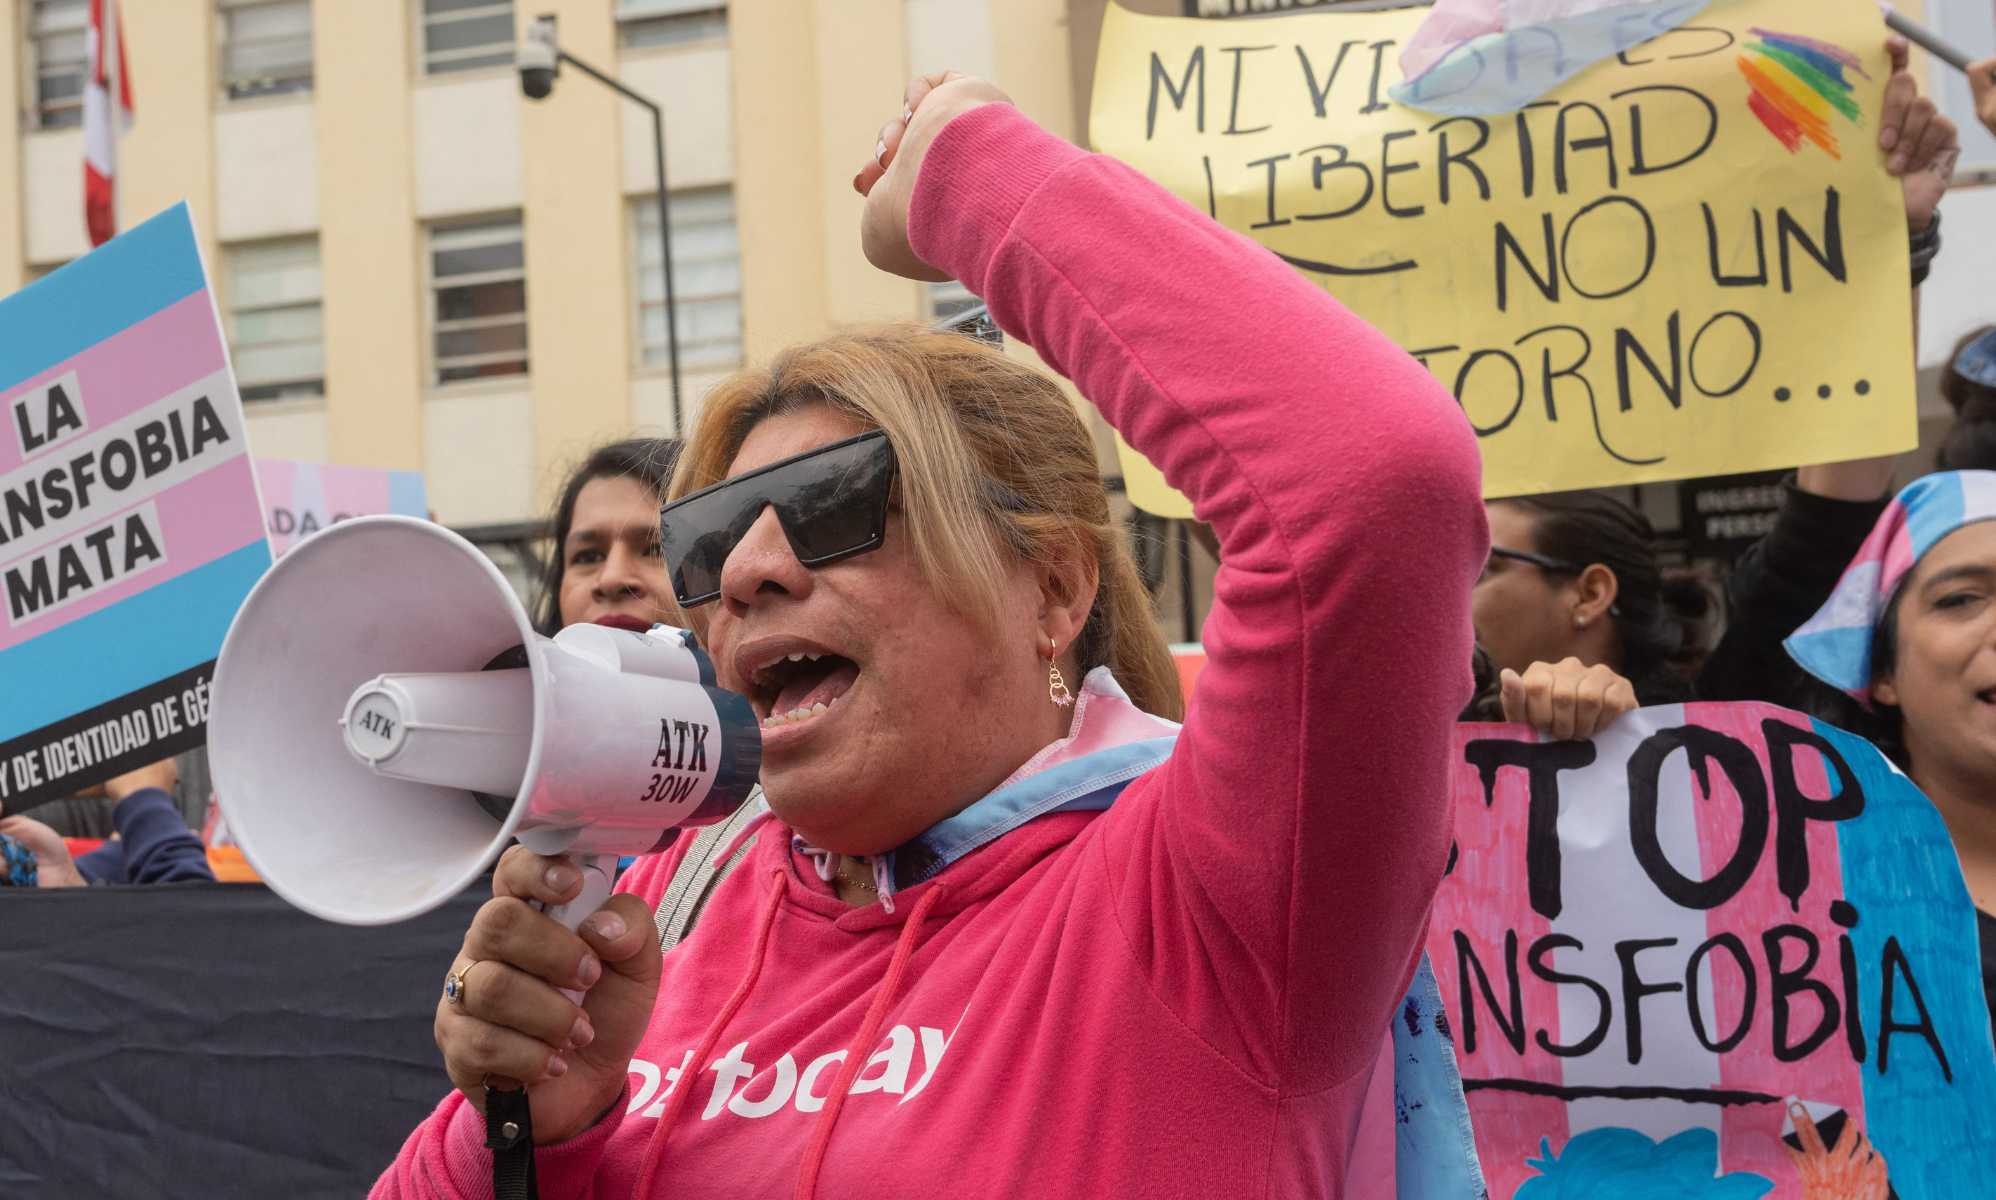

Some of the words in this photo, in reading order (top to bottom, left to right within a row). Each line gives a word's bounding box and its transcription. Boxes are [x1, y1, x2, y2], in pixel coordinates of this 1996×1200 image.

[1146, 44, 1279, 141] MI
[1495, 195, 1656, 312] NO
[1702, 185, 1847, 293] UN
[15, 384, 83, 453] LA
[0, 395, 231, 546] NSFOBIA
[5, 513, 161, 620] MATA
[13, 750, 43, 792] DE
[43, 709, 150, 781] IDENTIDAD
[151, 695, 183, 740] DE
[182, 676, 215, 727] GÉ
[359, 709, 396, 740] ATK
[651, 718, 709, 772] ATK
[640, 773, 699, 804] 30W
[1444, 718, 1867, 921] TOP
